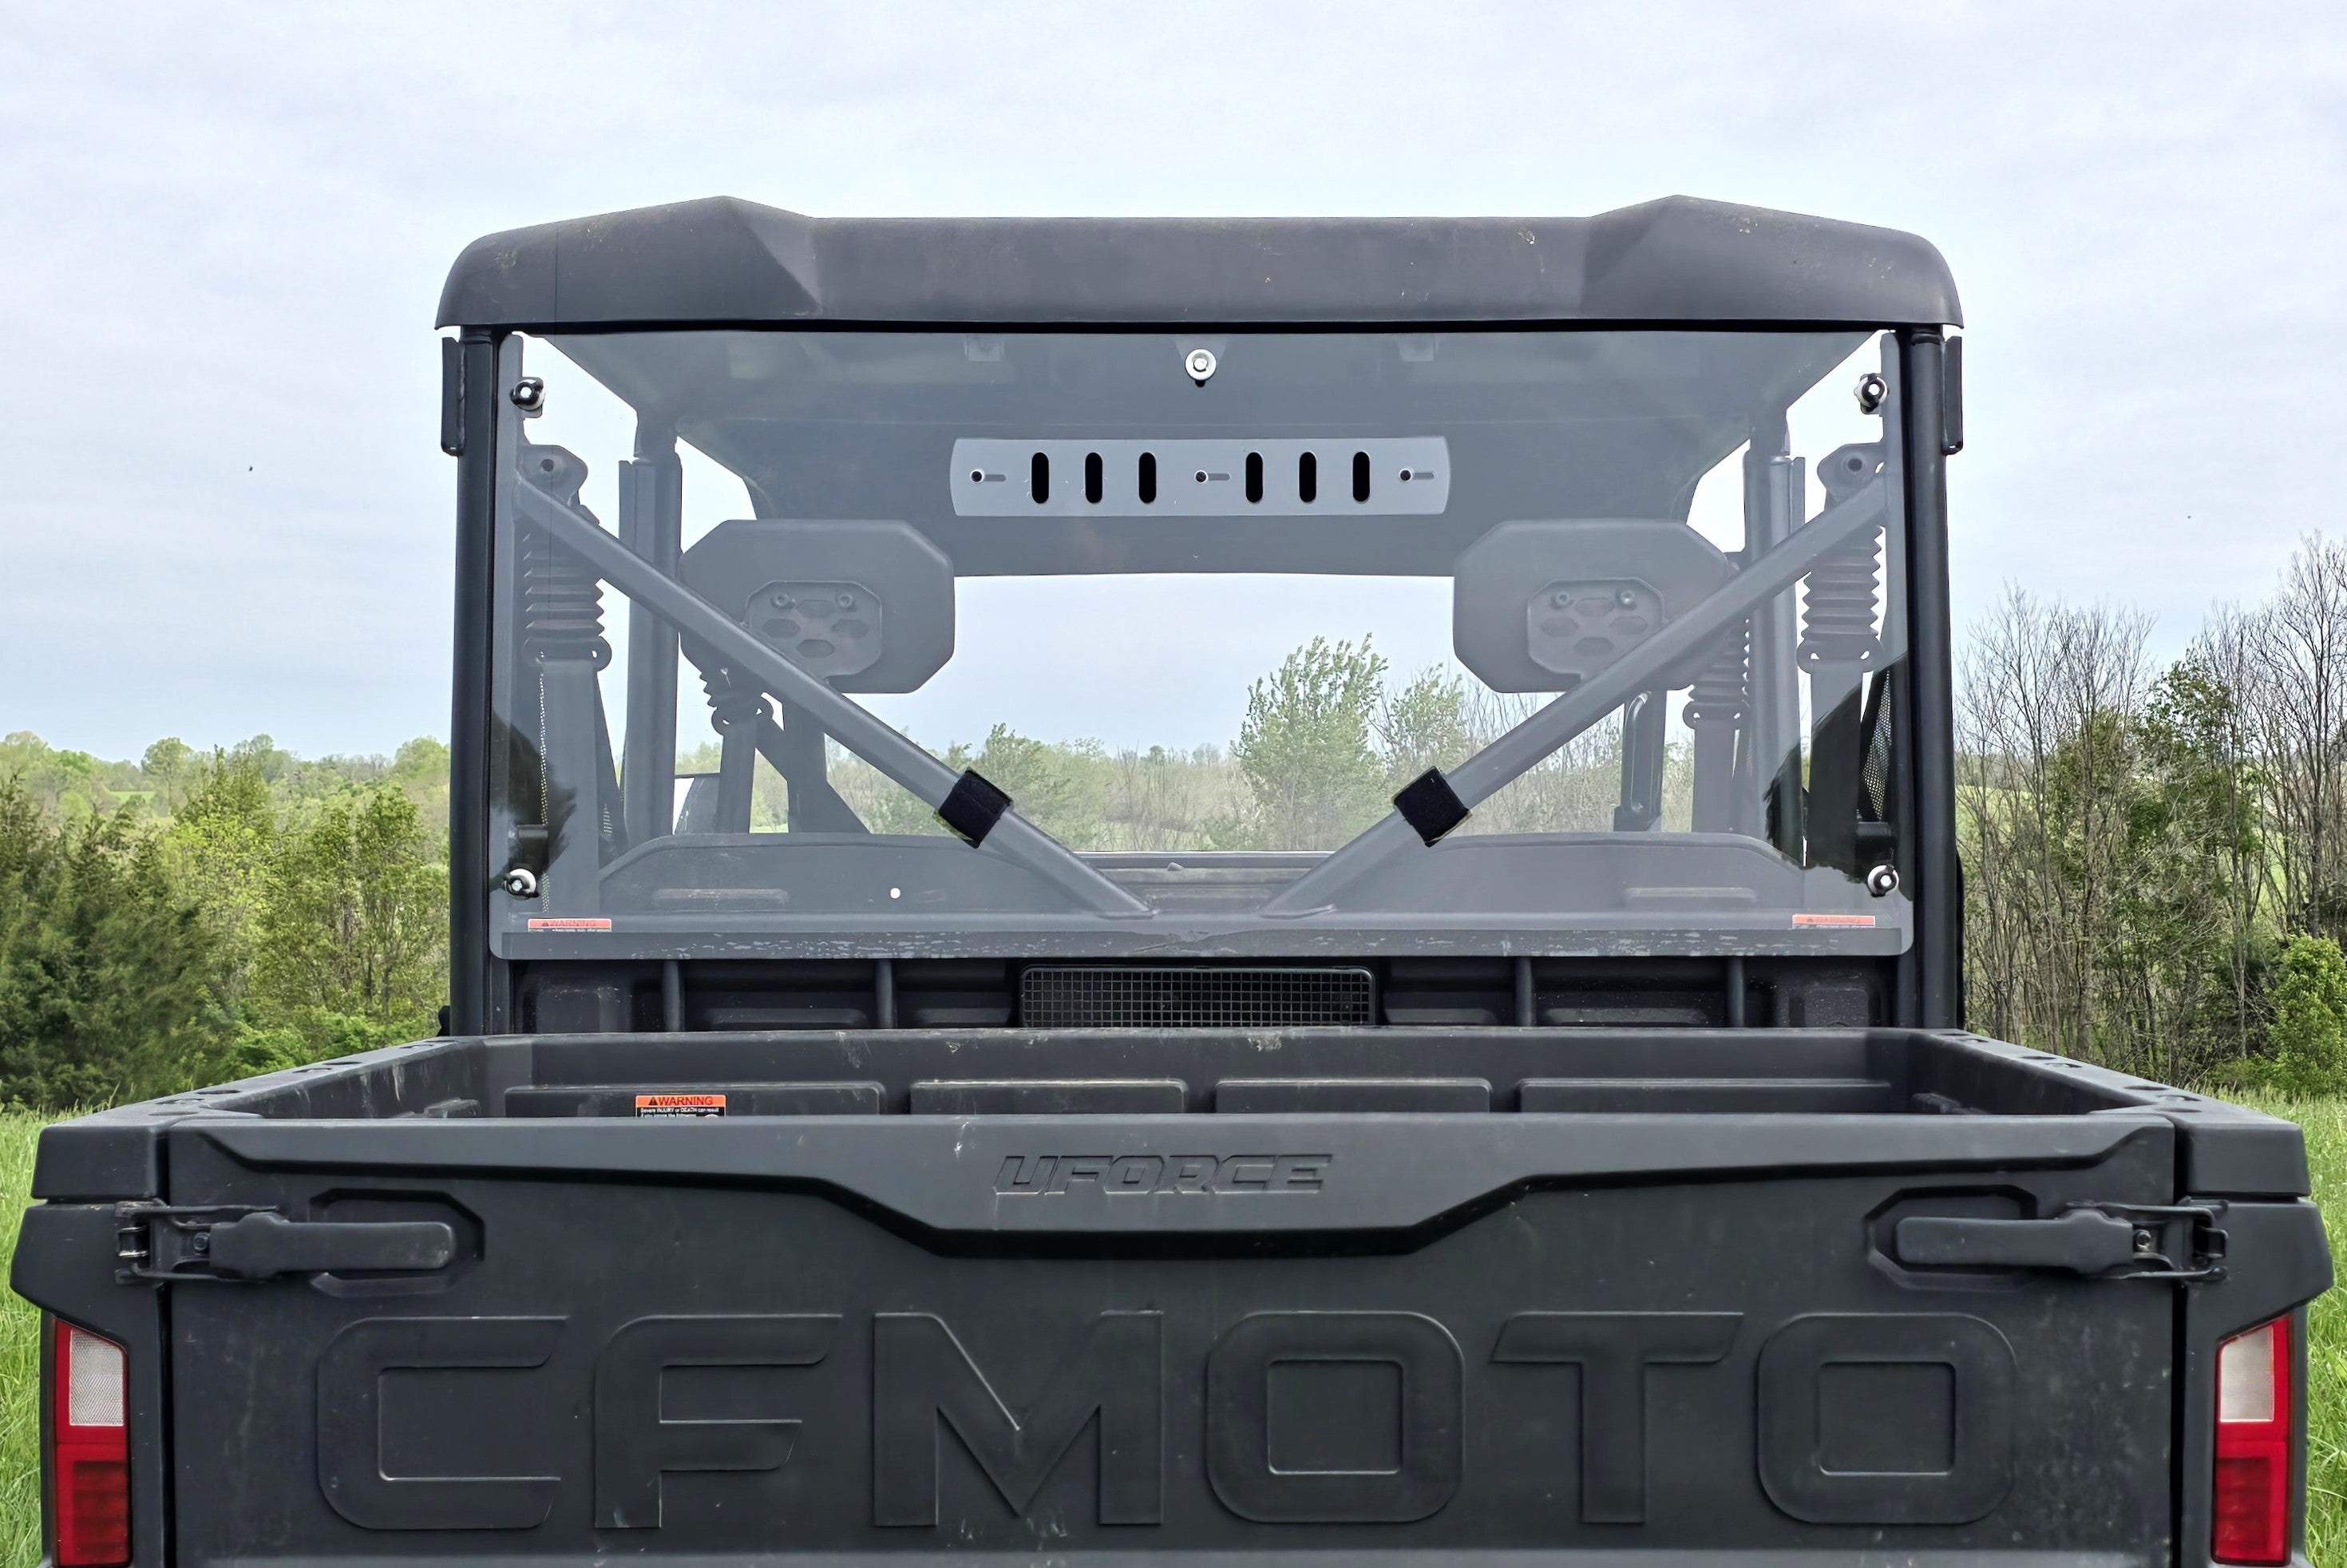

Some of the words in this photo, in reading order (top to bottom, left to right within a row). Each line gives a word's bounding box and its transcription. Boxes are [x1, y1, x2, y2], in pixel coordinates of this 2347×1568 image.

[659, 1096, 713, 1106] WARNING
[993, 1154, 1333, 1195] UFORCE
[316, 1309, 2017, 1530] CFMOTO
